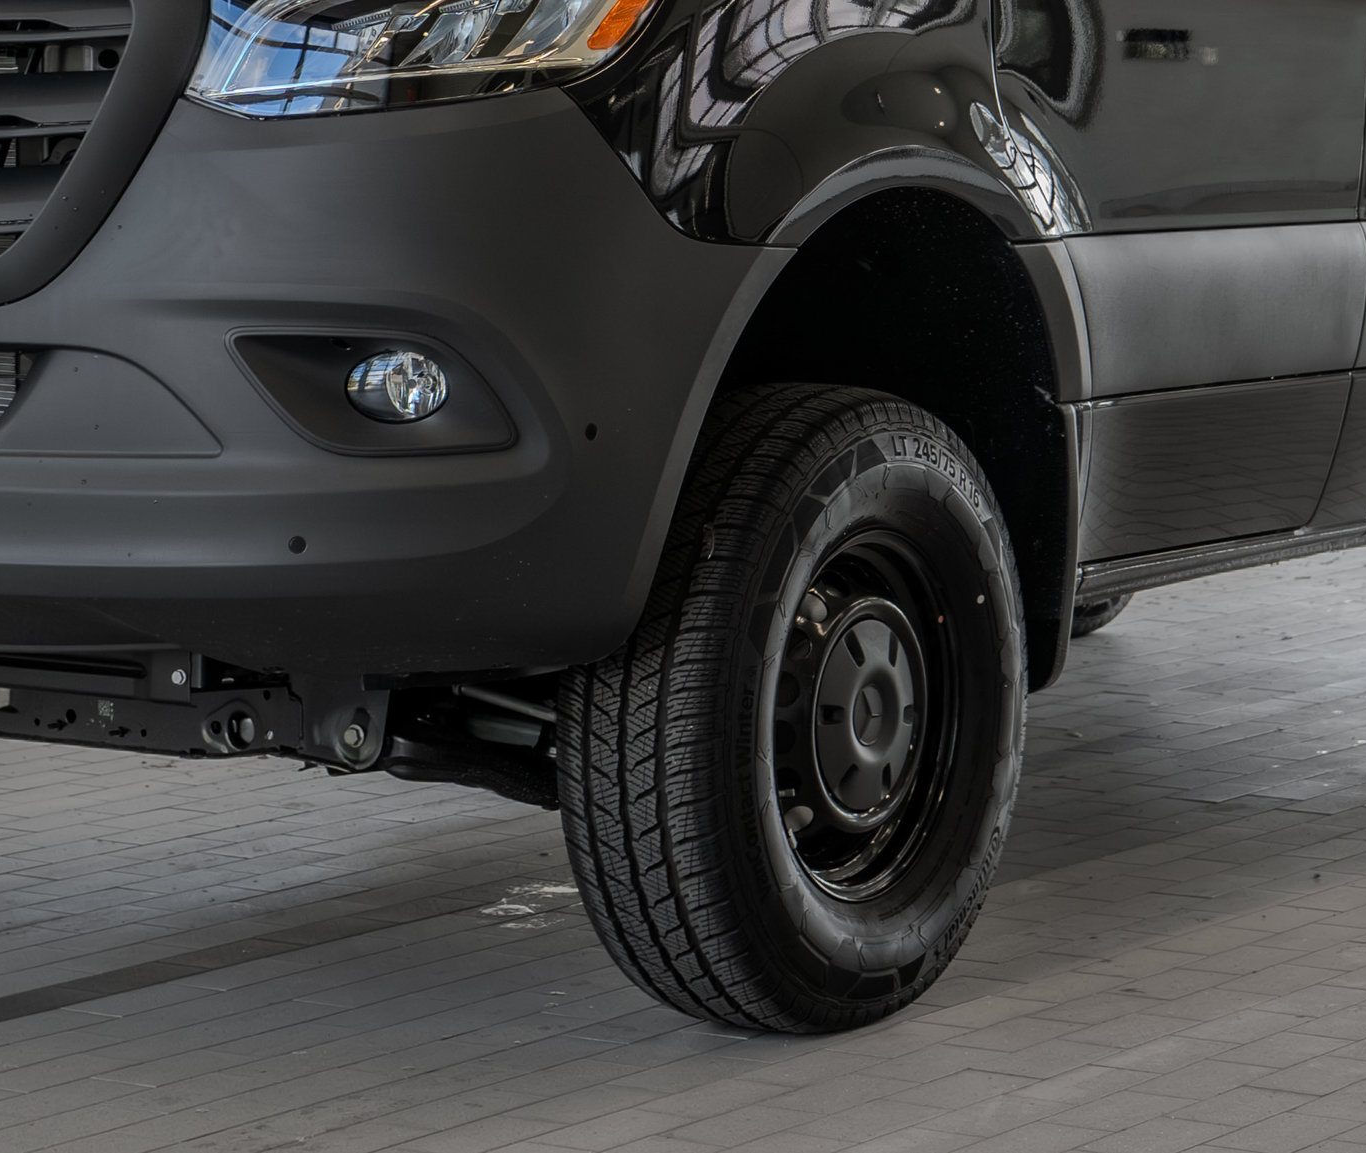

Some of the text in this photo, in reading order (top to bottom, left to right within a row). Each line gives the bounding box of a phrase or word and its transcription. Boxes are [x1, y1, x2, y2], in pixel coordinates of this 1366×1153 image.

[891, 435, 980, 508] LT 245/75 R 16
[735, 684, 755, 770] Winter
[943, 826, 1001, 951] Continental
